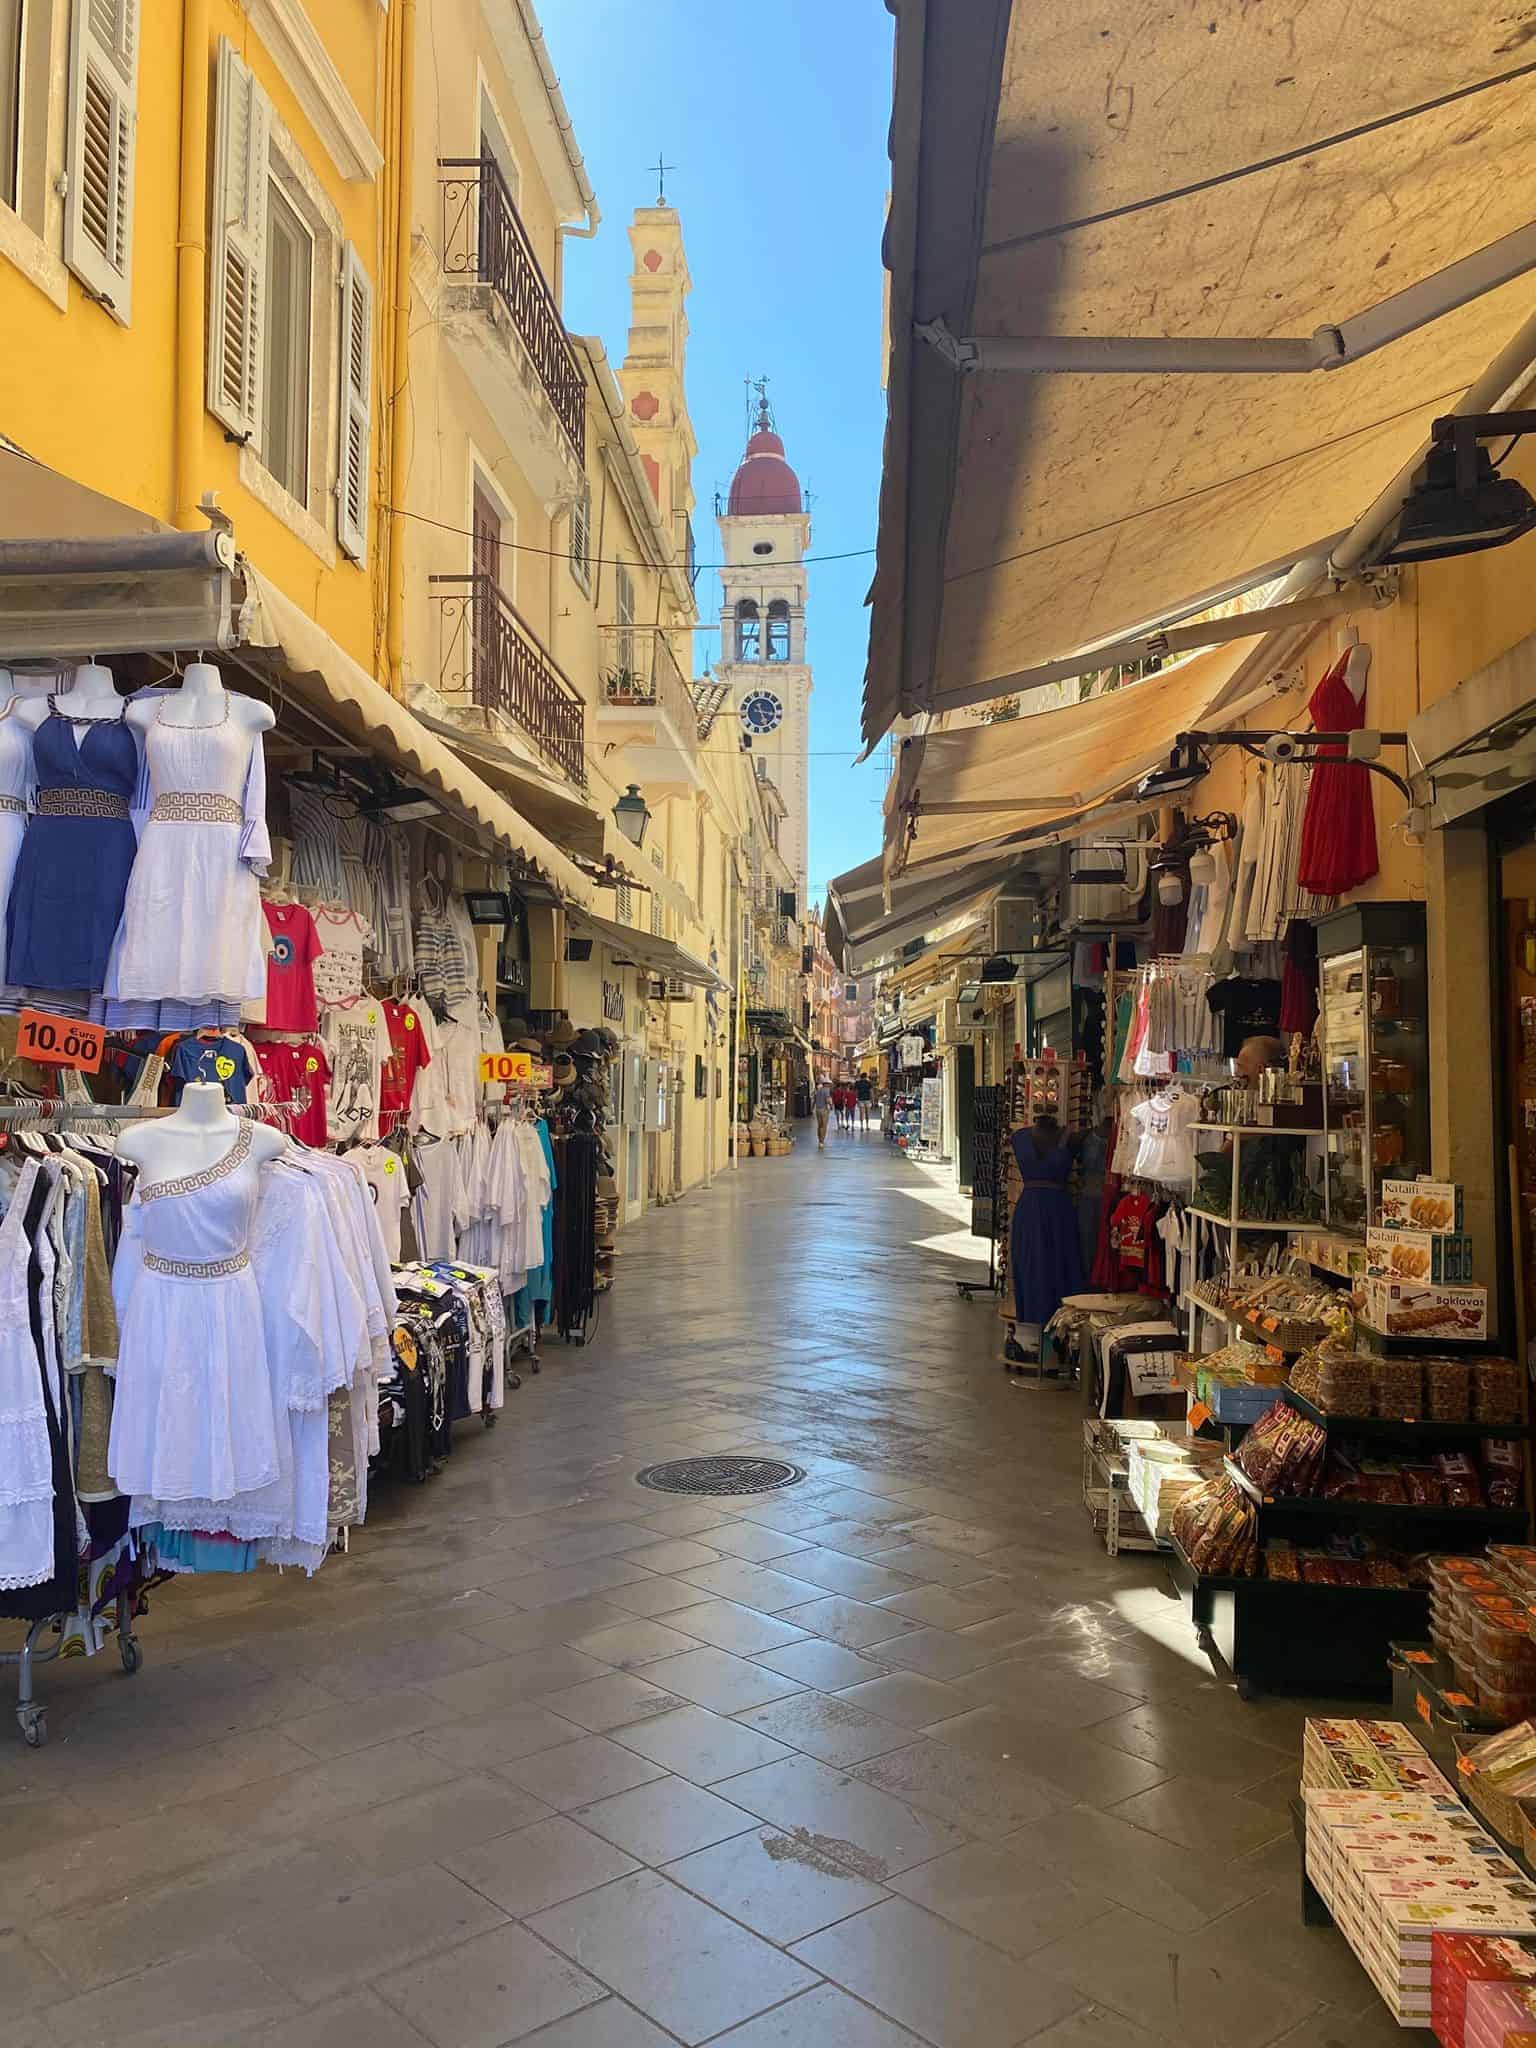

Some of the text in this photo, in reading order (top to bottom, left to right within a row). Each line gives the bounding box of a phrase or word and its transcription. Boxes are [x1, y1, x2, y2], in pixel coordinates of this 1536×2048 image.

[24, 1022, 97, 1060] 10.00
[1385, 1183, 1419, 1194] Kataifi
[1436, 1295, 1484, 1306] Baklavas
